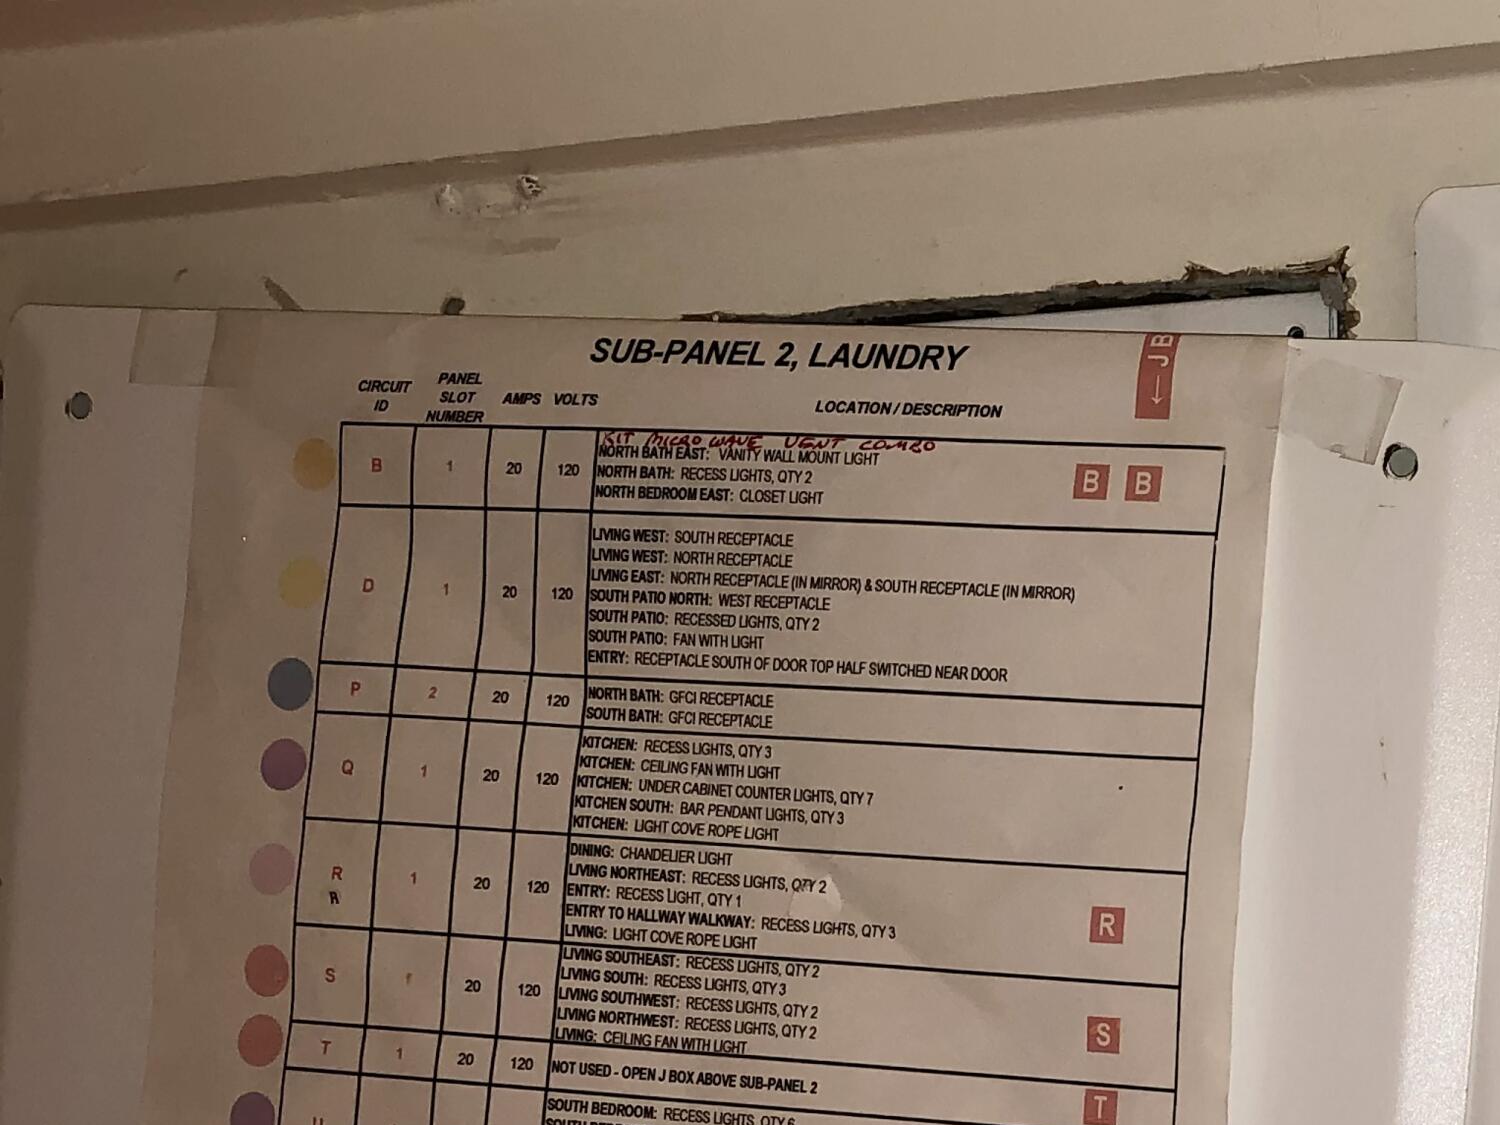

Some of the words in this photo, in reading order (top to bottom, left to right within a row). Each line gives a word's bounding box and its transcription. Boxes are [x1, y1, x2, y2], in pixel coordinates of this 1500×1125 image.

[590, 337, 765, 366] SUB-PANEL
[774, 341, 797, 372] 2,
[808, 342, 970, 370] LAUNDRY
[437, 372, 482, 384] PANEL
[358, 379, 412, 393] CIRCUIT
[439, 391, 476, 403] SLOT
[502, 392, 541, 405] AMPS
[554, 392, 598, 406] VOLTS
[373, 399, 389, 411] ID
[814, 400, 892, 415] LOCATION
[892, 402, 900, 415] /
[901, 402, 1003, 418] DESCRIPTION
[425, 411, 485, 423] NUMBER
[602, 432, 635, 445] KIT
[649, 433, 702, 449] MICRO
[598, 443, 639, 458] NORTH
[641, 445, 673, 459] BATH
[675, 446, 709, 460] EAST:
[718, 447, 761, 461] VANITY
[763, 449, 795, 463] WALL
[797, 450, 841, 464] MOUNT
[843, 451, 880, 465] LIGHT
[371, 457, 382, 472] B
[446, 460, 452, 471] 1
[505, 461, 522, 474] 20
[558, 463, 579, 476] 120
[596, 464, 637, 478] NORTH
[639, 465, 674, 479] BATH:
[680, 466, 726, 481] RECESS
[729, 468, 774, 484] LIGHTS,
[777, 469, 802, 483] QTY
[804, 470, 812, 484] 2
[1082, 470, 1100, 494] B
[1133, 472, 1152, 496] B
[595, 484, 635, 498] NORTH
[637, 485, 697, 500] BEDROOM
[699, 487, 733, 501] EAST:
[739, 488, 786, 503] CLOSET
[789, 490, 823, 504] LIGHT
[592, 527, 630, 541] LIVING
[633, 529, 669, 543] WEST:
[674, 530, 714, 544] SOUTH
[717, 531, 793, 547] RECEPTACLE
[362, 578, 374, 592] D
[443, 582, 448, 595] 1
[502, 585, 517, 598] 20
[551, 587, 573, 600] 120
[588, 650, 628, 665] ENTRY:
[634, 651, 710, 668] RECEPTACLE
[711, 655, 751, 669] SOUTH
[753, 656, 770, 670] OF
[772, 657, 807, 672] DOOR
[810, 658, 834, 673] TOP
[836, 660, 866, 674] HALF
[868, 661, 932, 678] SWITCHED
[934, 665, 968, 680] NEAR
[970, 666, 1007, 682] DOOR
[321, 1040, 331, 1054] T
[396, 1047, 402, 1059] 1
[456, 1052, 474, 1065] 20
[511, 1056, 533, 1070] 120
[551, 1057, 576, 1077] NOT
[579, 1062, 611, 1077] USED
[621, 1065, 656, 1081] OPEN
[657, 1069, 666, 1081] J
[668, 1069, 694, 1084] BOX
[695, 1071, 737, 1087] ABOVE
[739, 1075, 807, 1093] SUB-PANEL
[809, 1081, 817, 1094] 2
